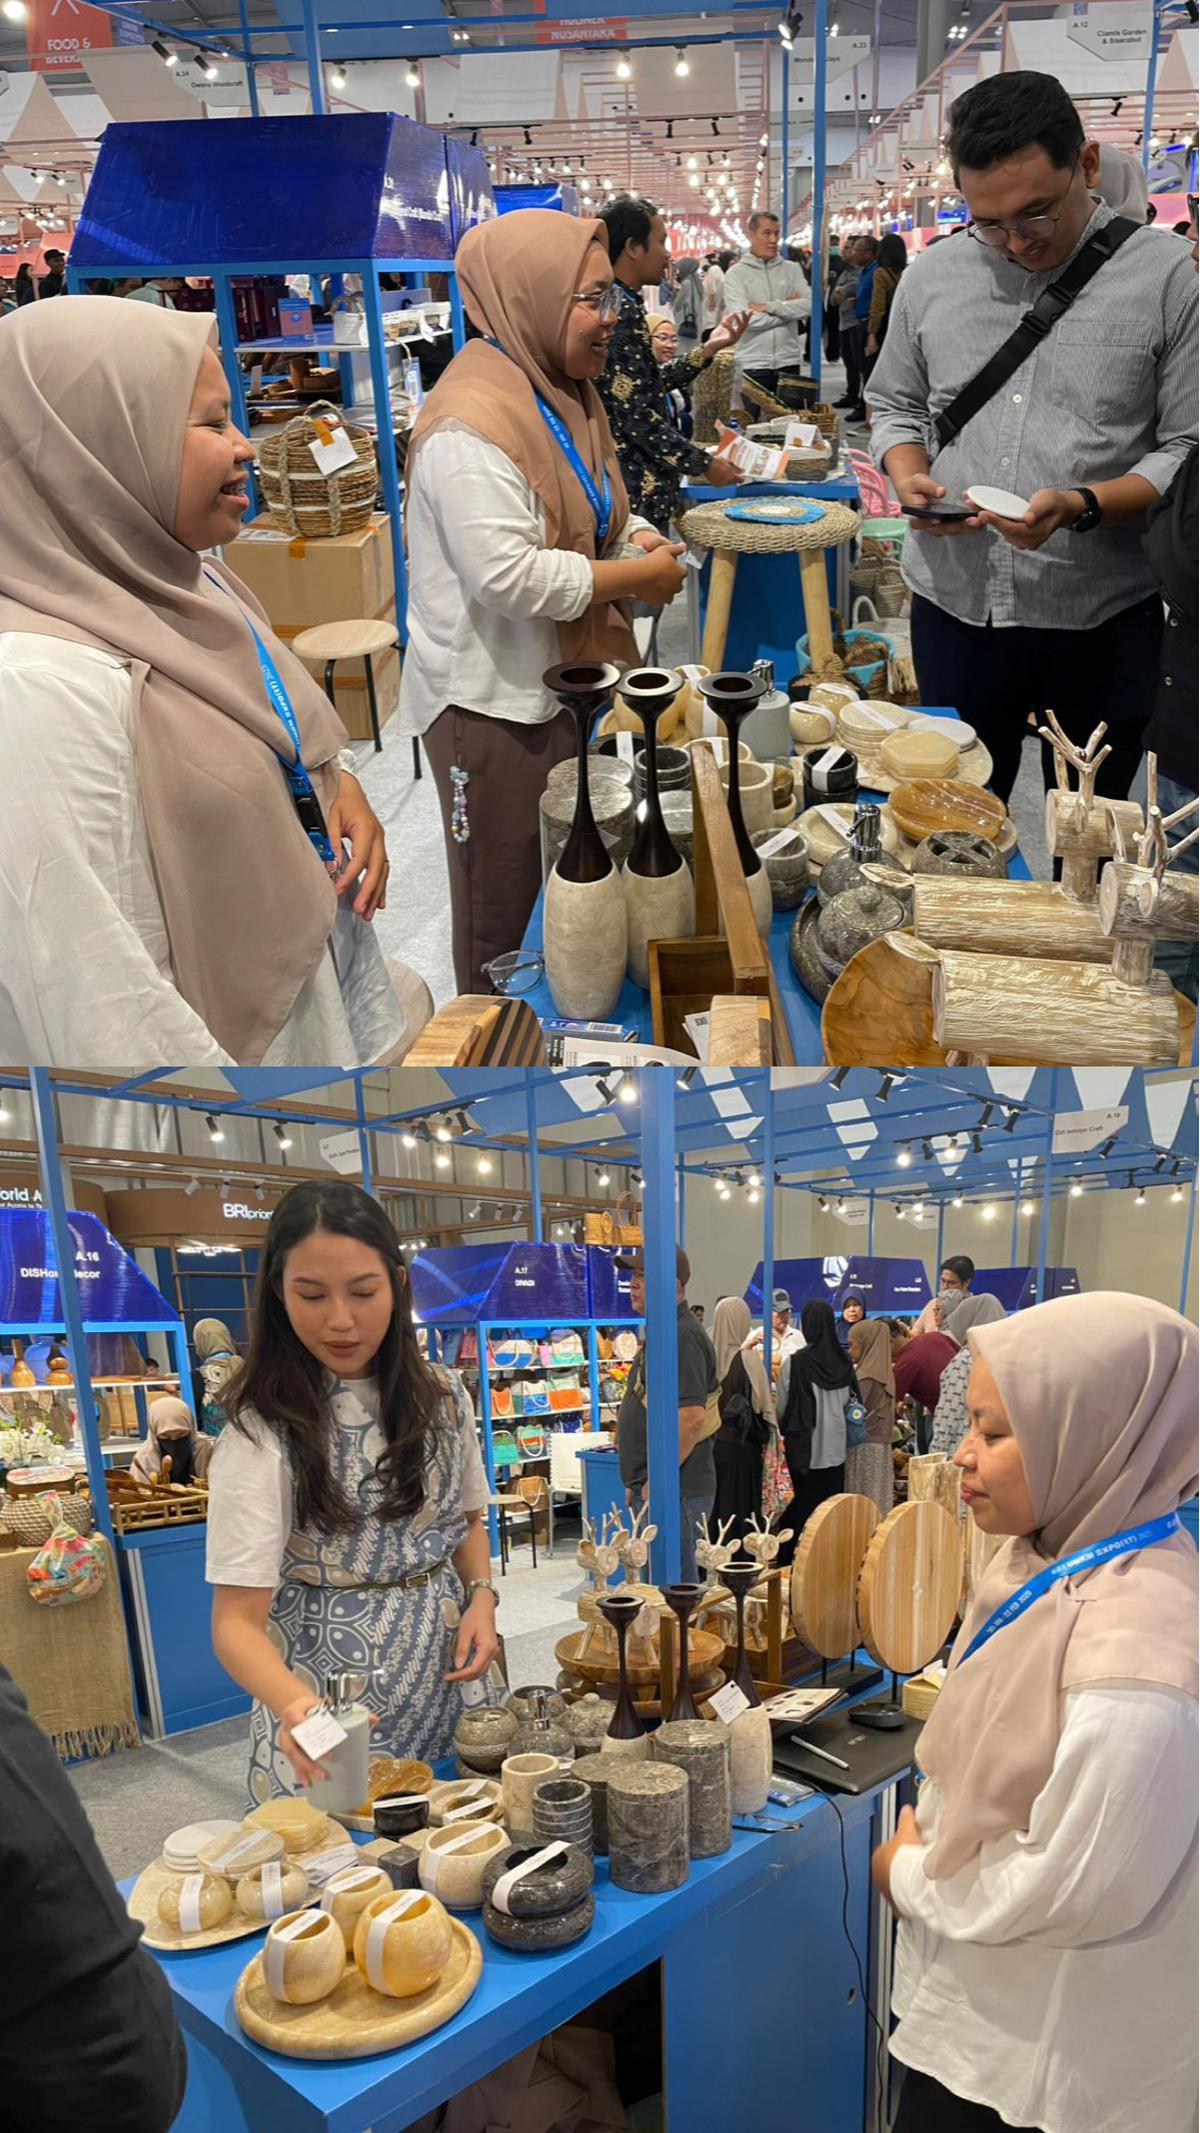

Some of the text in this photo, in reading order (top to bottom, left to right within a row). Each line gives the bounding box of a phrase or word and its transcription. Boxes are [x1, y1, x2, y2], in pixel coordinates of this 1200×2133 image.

[47, 37, 92, 51] FOOD &
[0, 1187, 29, 1201] orld
[76, 1252, 100, 1261] A.16
